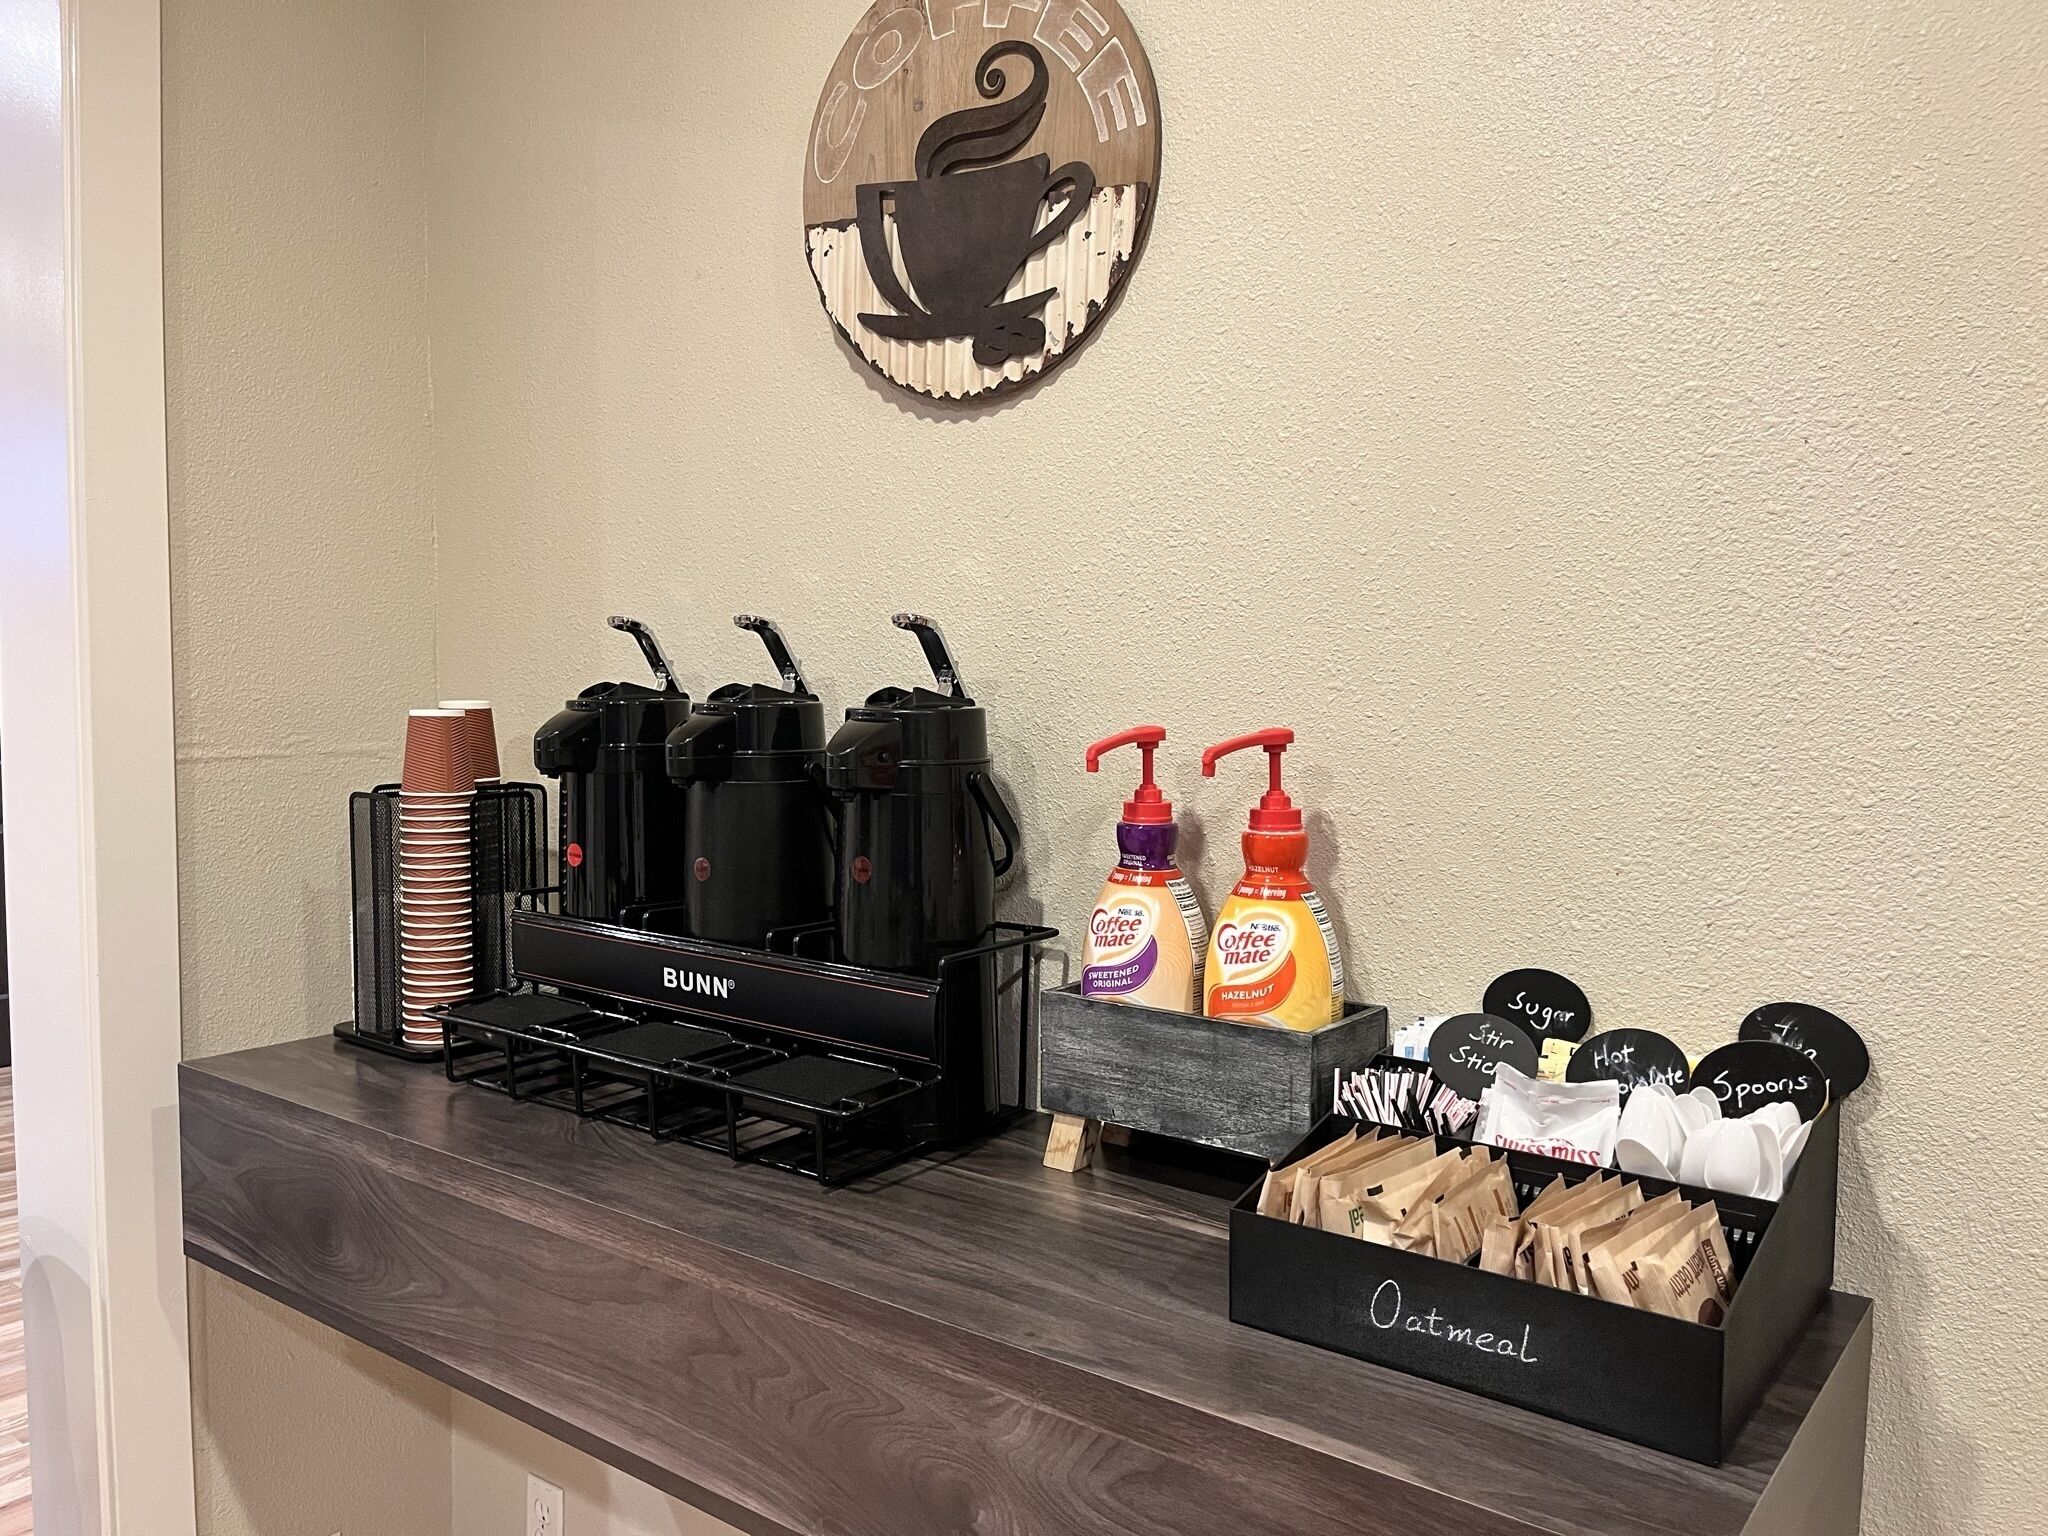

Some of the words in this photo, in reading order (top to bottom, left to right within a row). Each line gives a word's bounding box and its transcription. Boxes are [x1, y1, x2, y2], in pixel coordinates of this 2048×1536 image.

[1091, 909, 1142, 934] Coffee
[1094, 933, 1135, 947] mate
[1217, 924, 1276, 951] Coffee
[1224, 949, 1271, 965] mate
[1088, 964, 1139, 980] SWEETENED
[1092, 977, 1133, 988] ORIGINAL
[1221, 984, 1275, 1001] HAZELNUT
[1508, 991, 1576, 1030] Sugar
[1468, 1021, 1514, 1049] Stir
[1594, 1044, 1635, 1069] Hot
[1713, 1070, 1811, 1108] Spoons
[1371, 1279, 1538, 1363] Oatmeal
